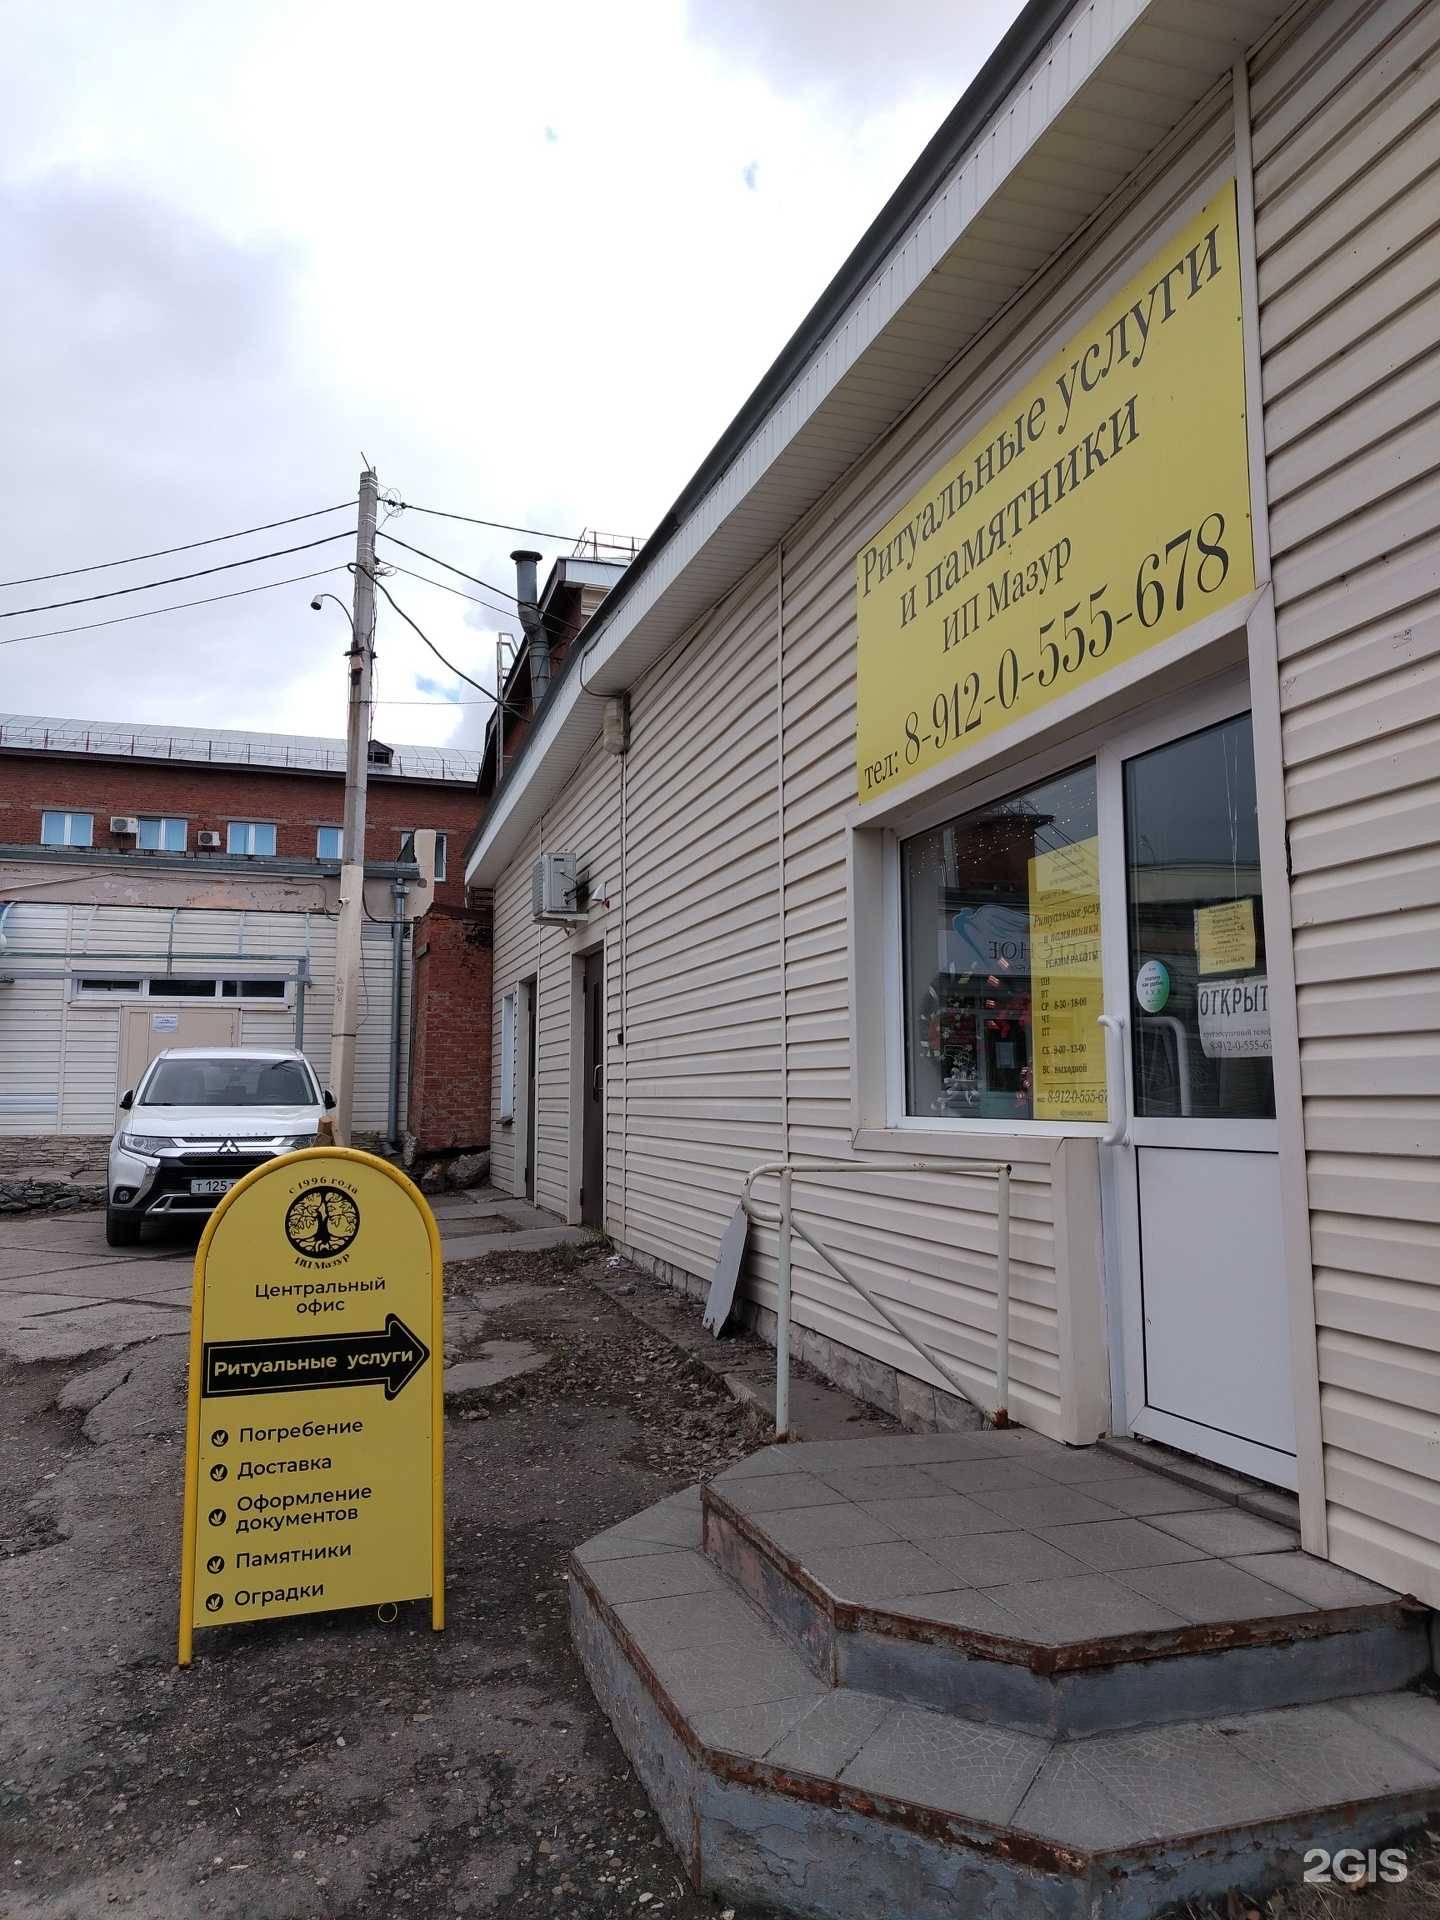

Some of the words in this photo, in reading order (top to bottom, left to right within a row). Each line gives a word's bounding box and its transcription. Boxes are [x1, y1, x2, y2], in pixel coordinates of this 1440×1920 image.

[862, 398, 1046, 597] Ритуальные
[1056, 224, 1221, 435] услуги
[900, 592, 917, 629] и
[926, 394, 1139, 608] памятники
[943, 599, 979, 654] ИП
[987, 536, 1072, 620] Мазур
[864, 748, 899, 790] тел:
[904, 512, 1229, 766] 8-912-0-555-678
[1082, 903, 1100, 918] услу
[1200, 984, 1268, 1016] ОТКРЫТ
[298, 1176, 327, 1189] 1996
[255, 1276, 385, 1300] Центральный
[296, 1299, 345, 1316] офис
[214, 1354, 338, 1377] Ритуальные
[347, 1349, 414, 1370] услуги
[239, 1420, 364, 1443] Погребение
[237, 1456, 332, 1480] Доставка
[236, 1487, 373, 1513] Оформление
[235, 1508, 359, 1534] документов
[235, 1544, 352, 1569] Памятники
[234, 1584, 325, 1607] Оградки
